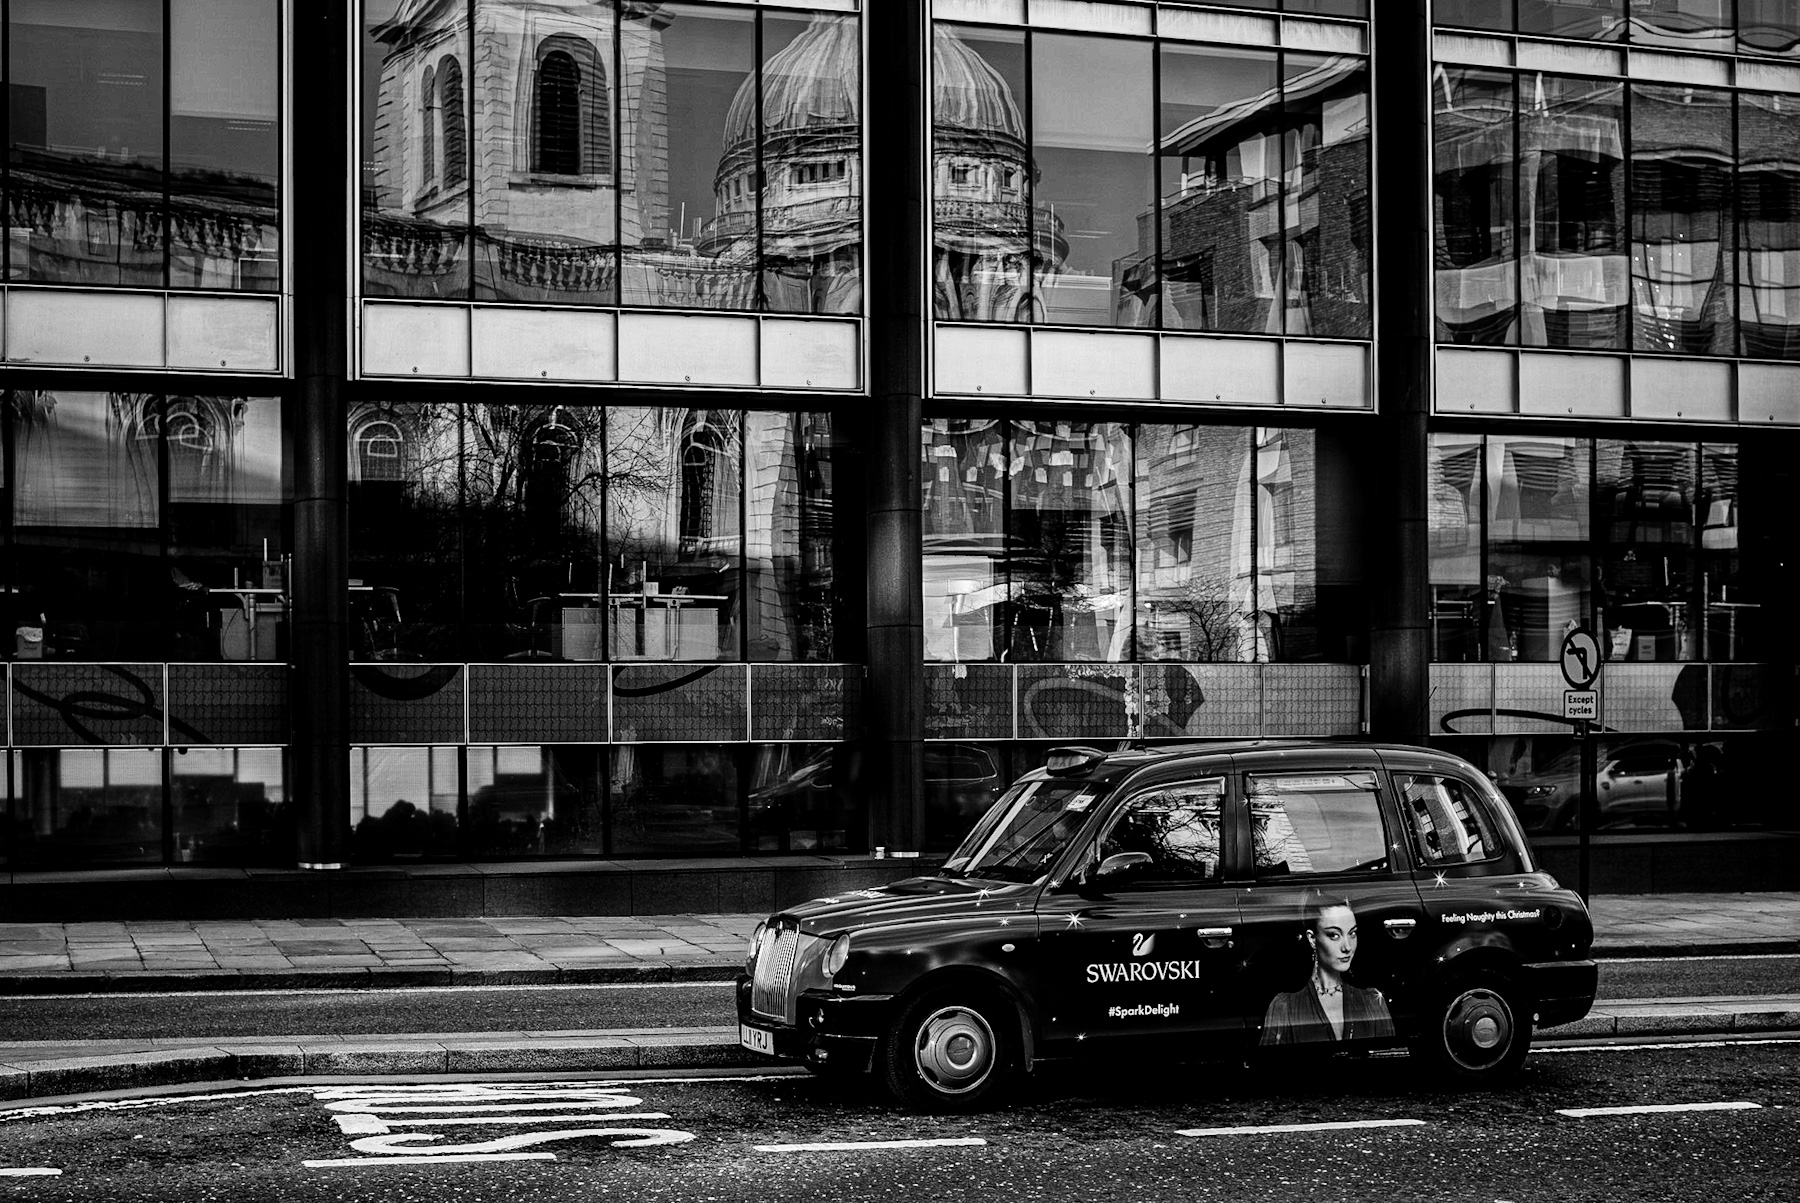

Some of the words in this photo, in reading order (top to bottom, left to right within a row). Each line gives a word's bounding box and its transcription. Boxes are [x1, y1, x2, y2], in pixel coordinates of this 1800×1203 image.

[1568, 695, 1594, 705] Except
[1569, 706, 1592, 715] cycles
[1441, 912, 1465, 924] Feeling
[1466, 911, 1495, 923] Naughty
[1496, 910, 1507, 920] this
[1507, 908, 1540, 920] Christmas?
[1086, 960, 1200, 983] SWAROVSKI
[1108, 1003, 1179, 1019] #SparkDelight
